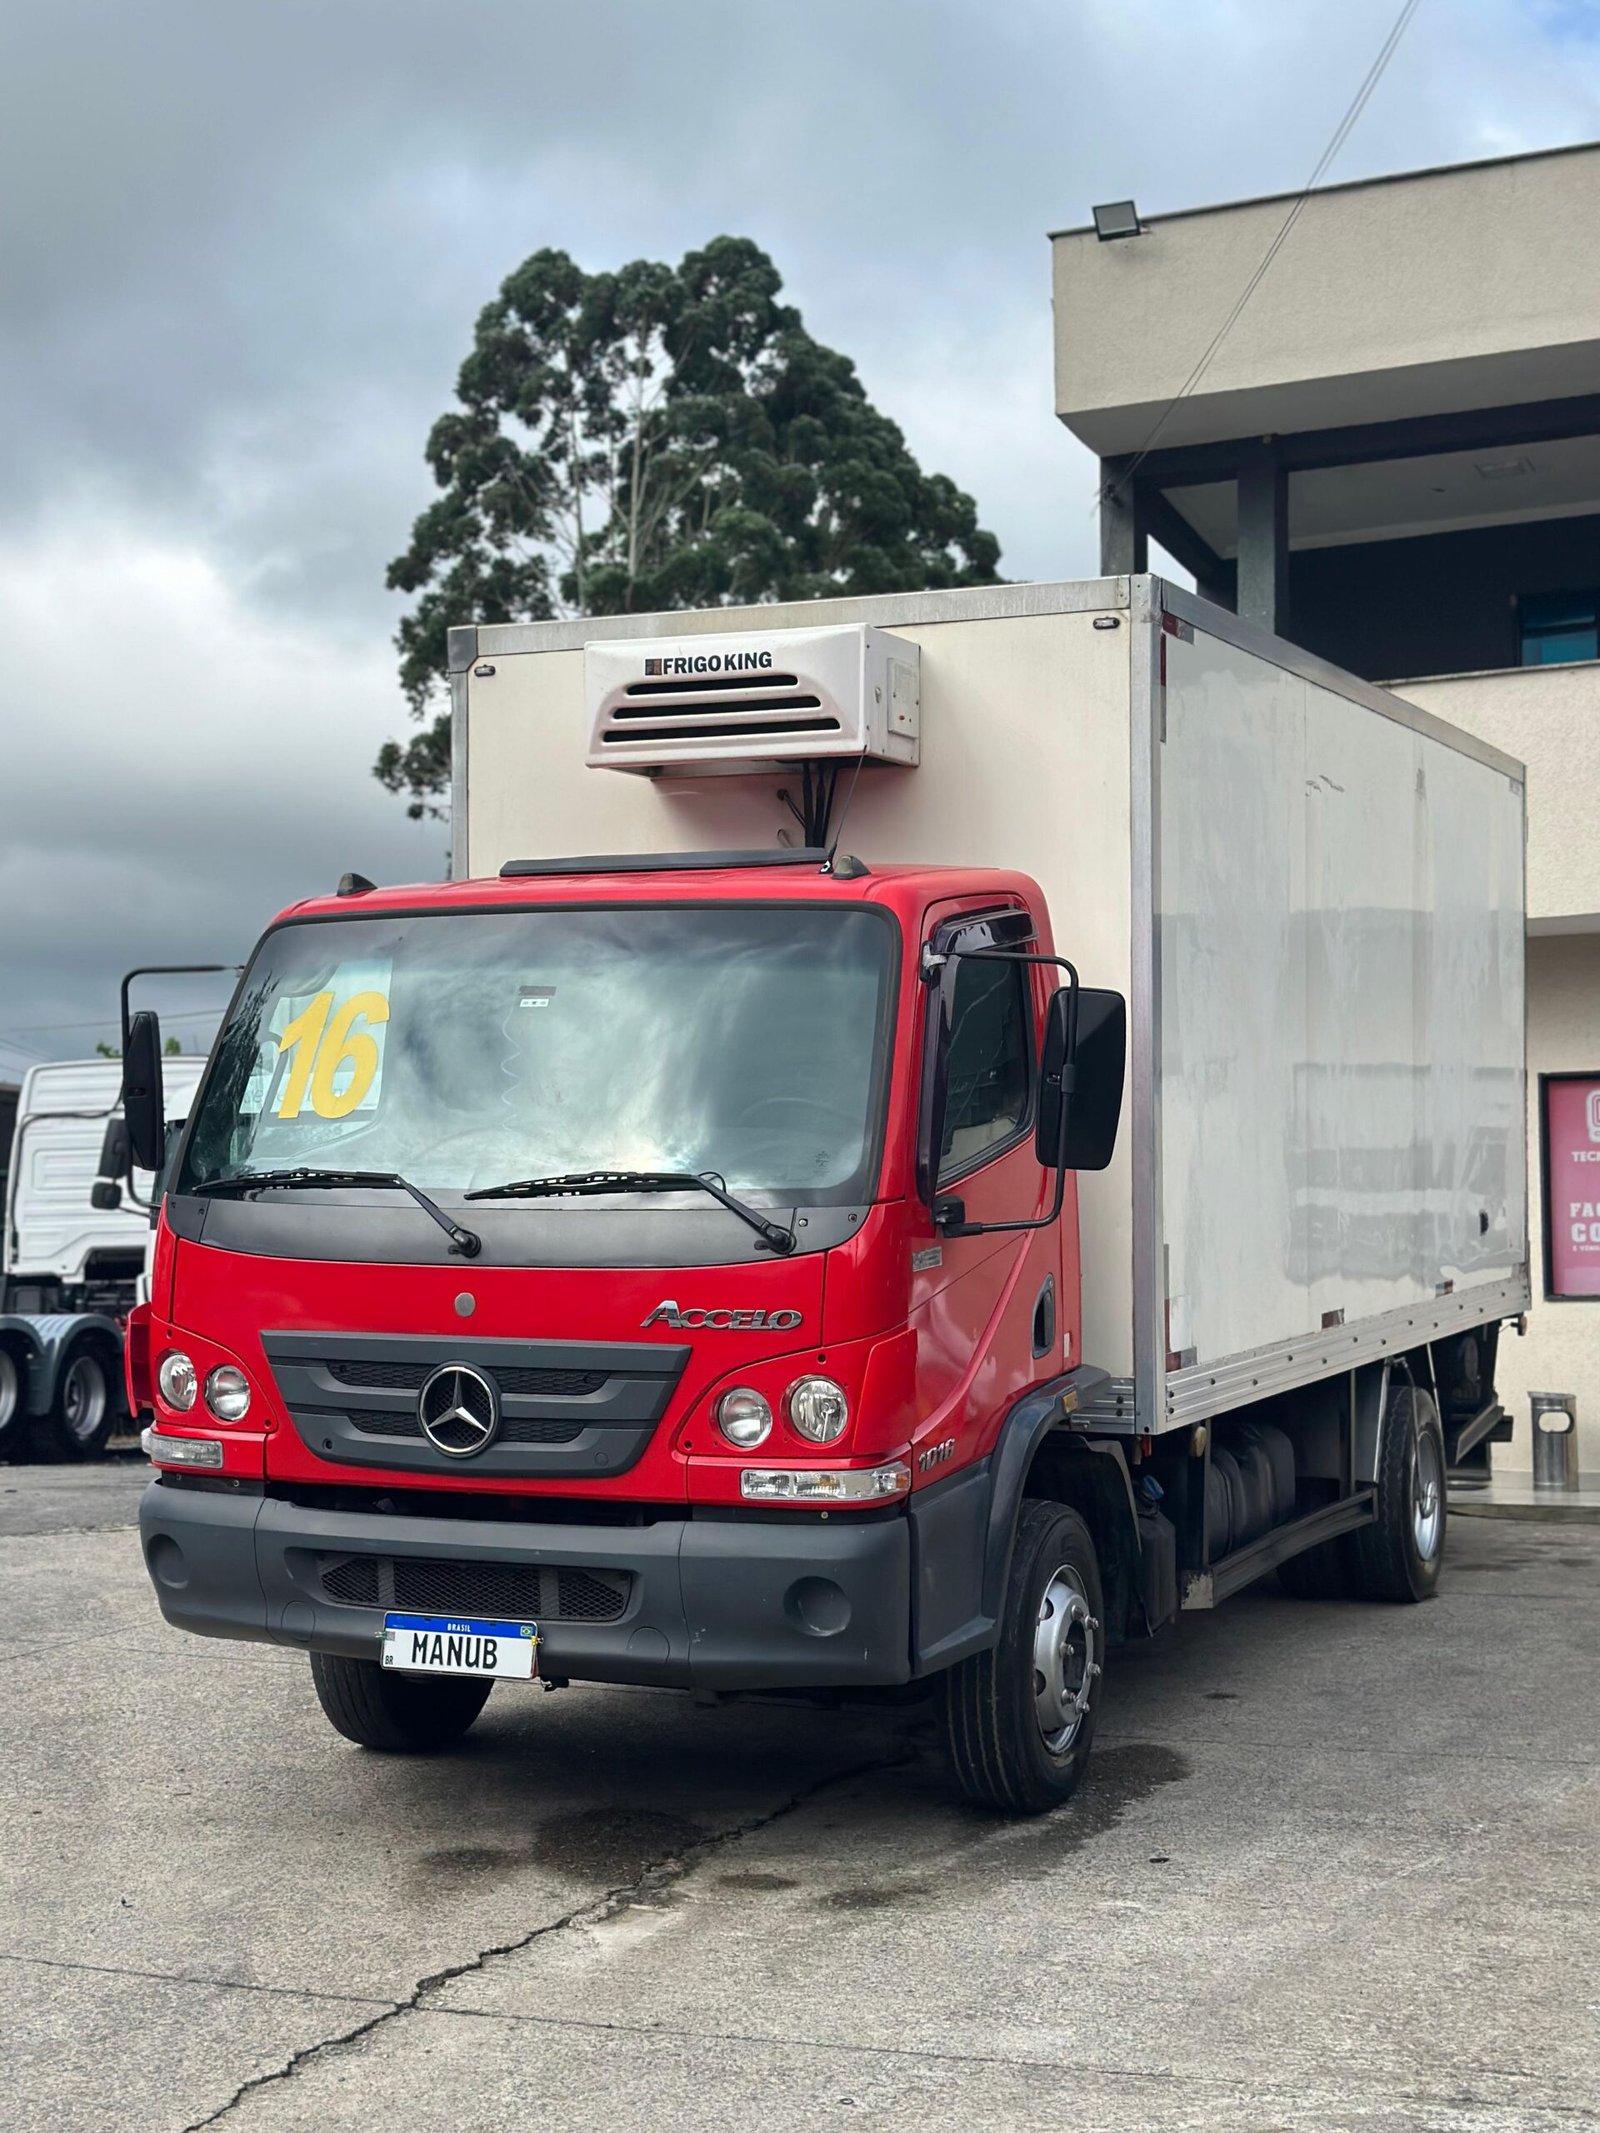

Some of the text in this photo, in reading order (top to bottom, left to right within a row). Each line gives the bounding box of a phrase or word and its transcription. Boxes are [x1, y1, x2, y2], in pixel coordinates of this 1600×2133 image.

[278, 991, 390, 1120] 16
[919, 1438, 955, 1472] 1016
[447, 1623, 471, 1632] BRASIL
[385, 1655, 394, 1665] BR
[412, 1633, 498, 1669] MANUB
